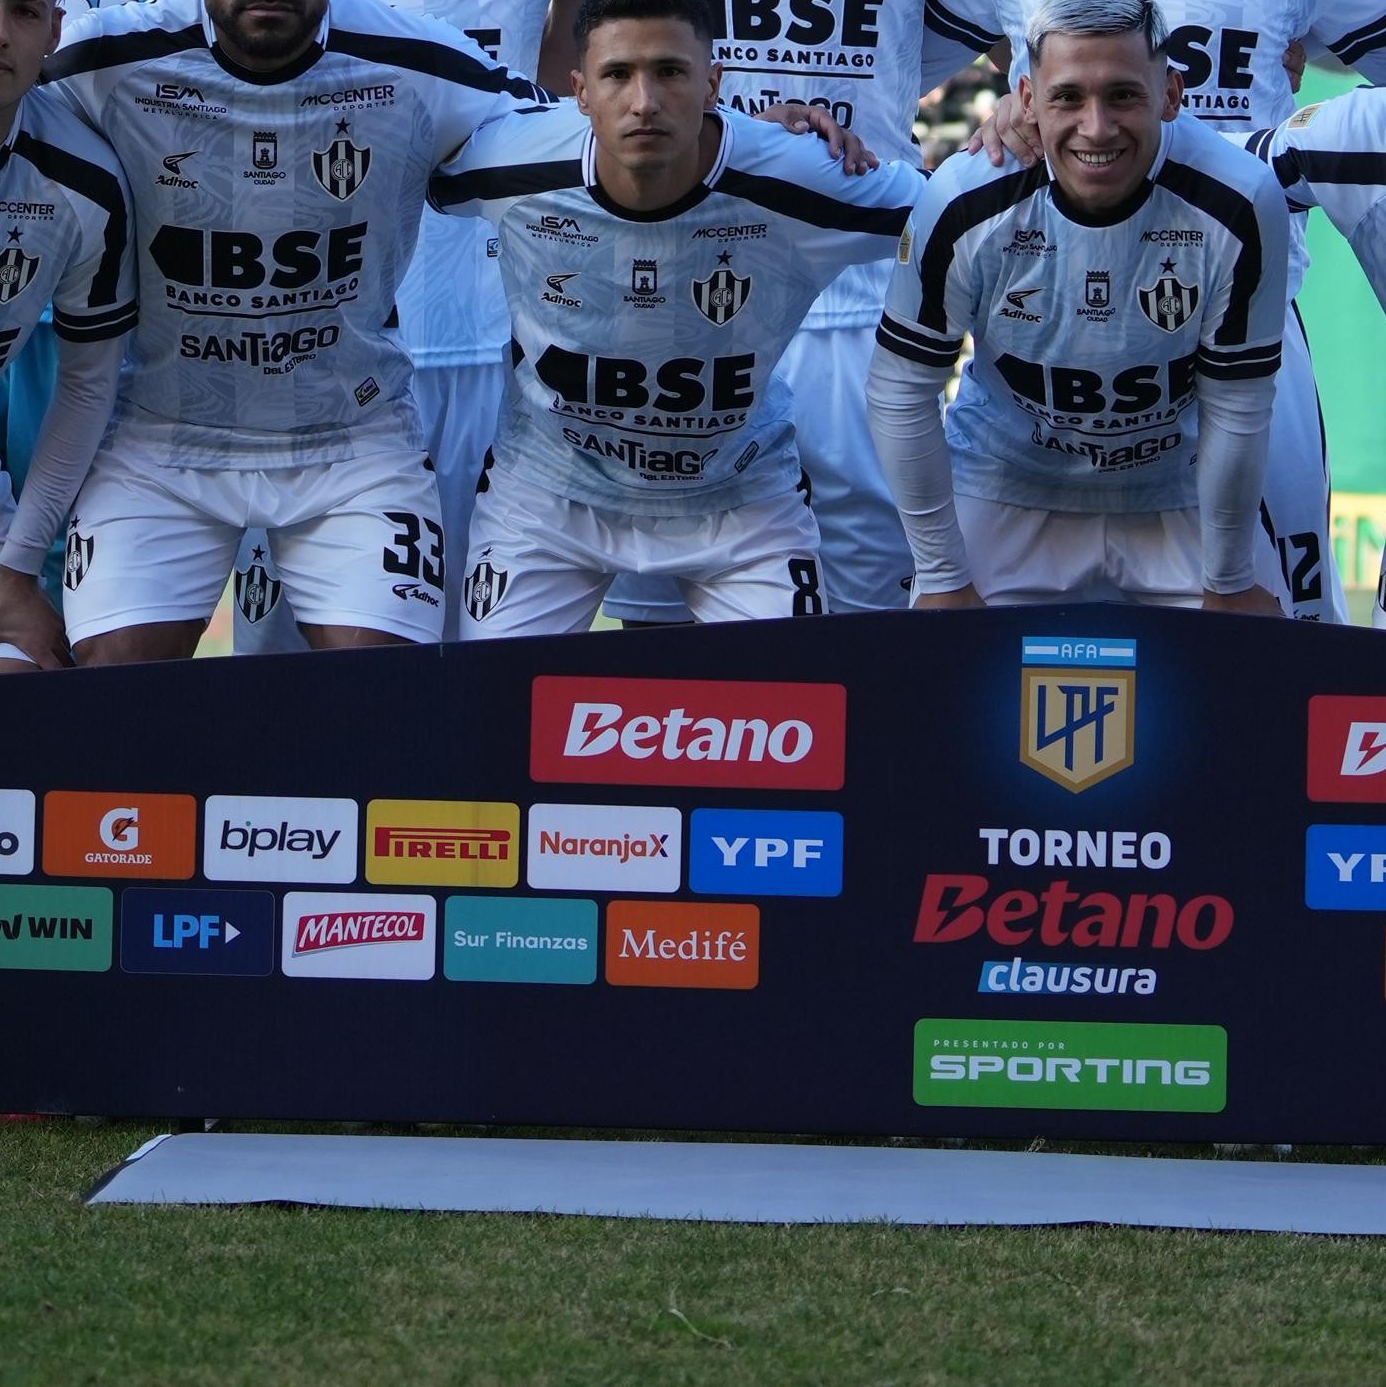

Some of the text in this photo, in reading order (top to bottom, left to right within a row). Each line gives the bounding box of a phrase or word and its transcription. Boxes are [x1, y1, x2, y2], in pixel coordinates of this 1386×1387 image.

[767, 48, 875, 67] SANTIAGO
[1166, 25, 1259, 89] SE
[155, 84, 205, 103] ISM
[301, 85, 395, 107] MCCENTER
[1181, 94, 1249, 110] NTIAGO
[134, 97, 227, 114] INDUSTRIA SANTIAGO
[333, 99, 395, 111] DEPORTES
[155, 174, 199, 190] Adhoc
[243, 171, 286, 179] SANTIAGO
[526, 224, 599, 243] INDUSTRIA SANTIAGO
[541, 215, 581, 232] ISM
[691, 223, 767, 239] MCCENTER
[1014, 230, 1046, 243] ISM
[210, 221, 368, 290] BSE
[166, 277, 359, 309] BANCO SANTIAGO
[541, 292, 582, 308] Adhoc
[623, 296, 666, 304] SANTIAGO
[999, 307, 1043, 323] Adhoc
[1076, 307, 1116, 317] SANTIAGO
[594, 352, 756, 414] BSE
[1051, 356, 1196, 414] BSE
[383, 512, 444, 592] 33
[1277, 532, 1321, 603] 12
[410, 589, 439, 607] Adhoc
[788, 559, 822, 616] 8
[1062, 644, 1097, 658] AFA
[564, 703, 813, 763] Betano
[220, 820, 340, 859] bplay
[374, 826, 510, 861] PIRELLI
[980, 829, 1171, 869] TORNEO
[85, 853, 152, 864] GATORADE
[712, 837, 823, 867] YPF
[913, 874, 1234, 950] Betano
[28, 917, 92, 939] WIN
[154, 914, 219, 949] LPF
[299, 915, 418, 948] MANTECOL
[454, 931, 587, 950] Sur Finanzas
[620, 929, 746, 961] Medifé
[985, 958, 1156, 994] clausura
[934, 1040, 1028, 1049] PRESENTADO
[930, 1055, 1210, 1085] SPORTING
